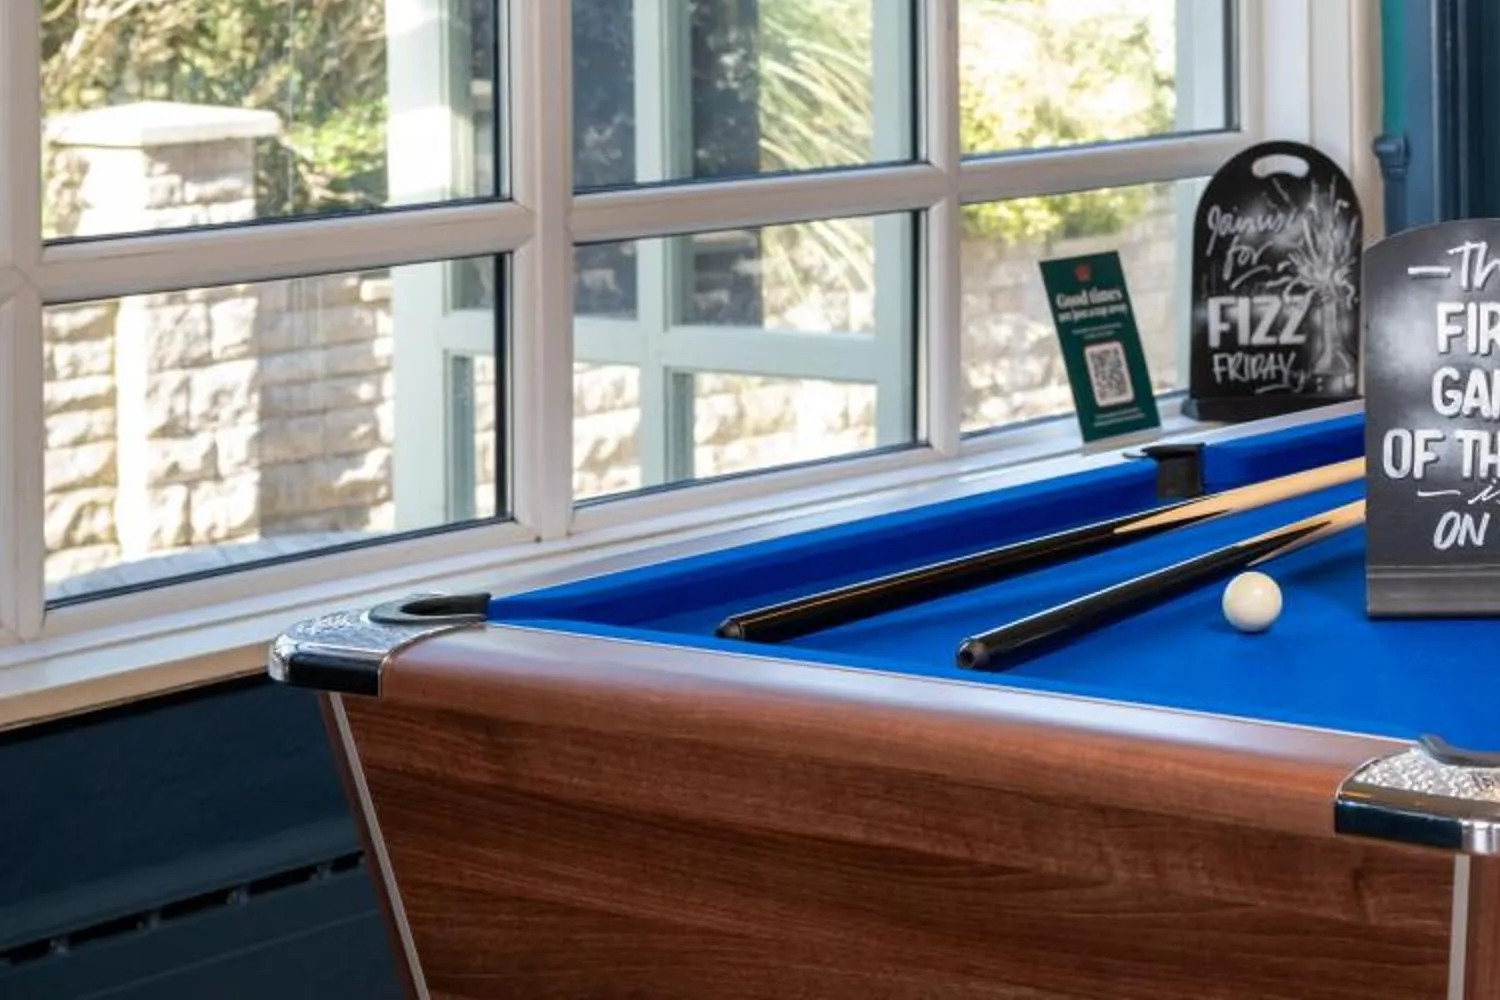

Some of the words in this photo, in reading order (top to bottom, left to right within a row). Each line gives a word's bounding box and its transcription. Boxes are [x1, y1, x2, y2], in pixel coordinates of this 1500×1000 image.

[1222, 235, 1274, 281] for
[1208, 291, 1313, 349] FIZZ
[1213, 351, 1296, 388] FRIDAY
[1383, 428, 1447, 480] OF
[1433, 511, 1489, 550] ON
